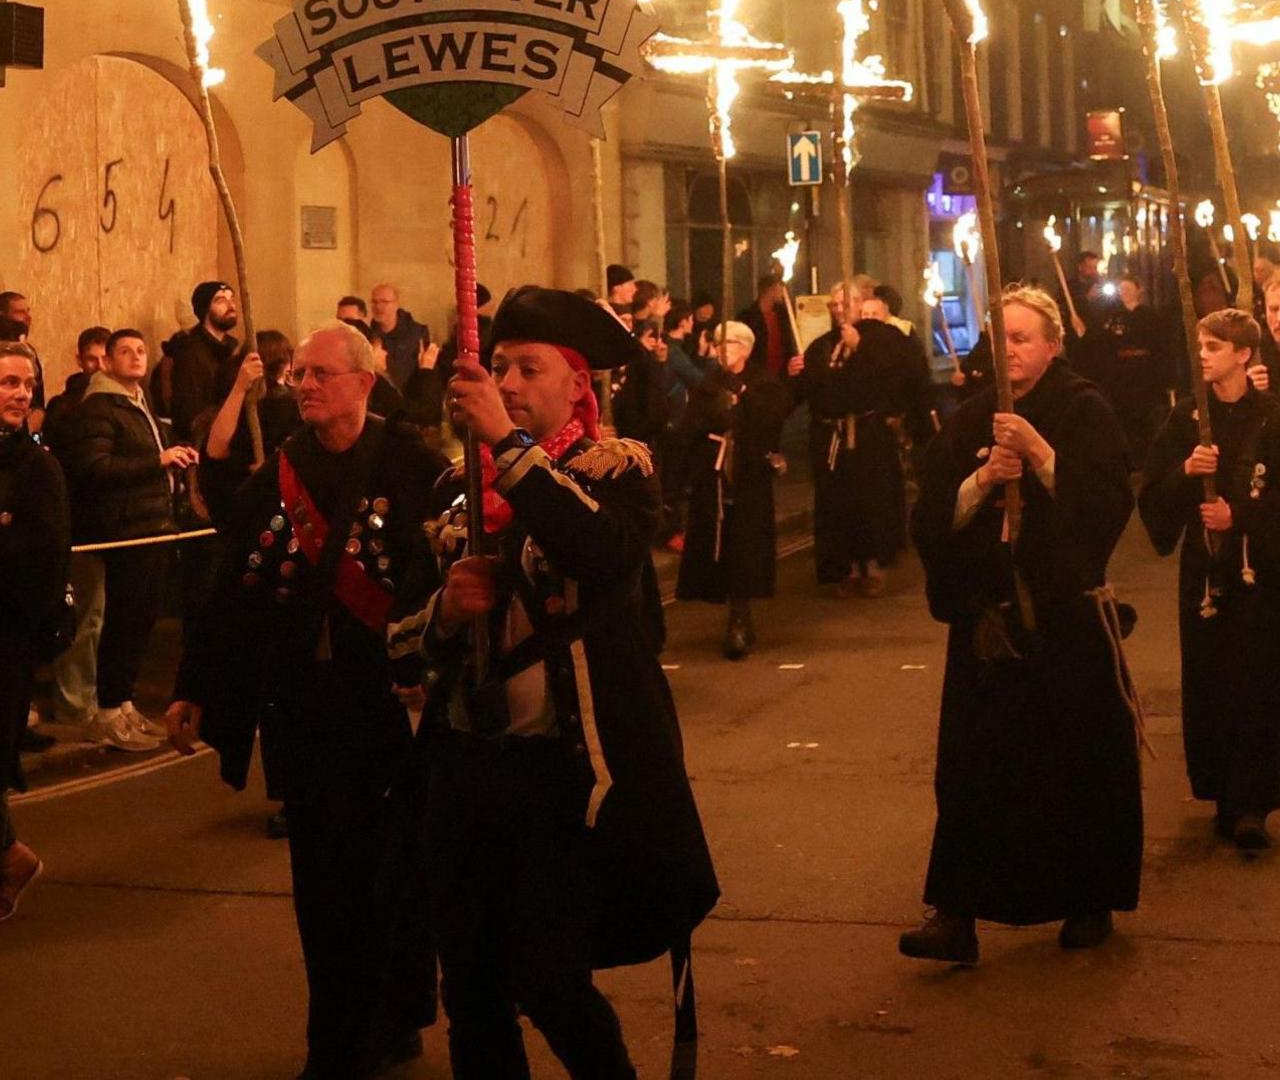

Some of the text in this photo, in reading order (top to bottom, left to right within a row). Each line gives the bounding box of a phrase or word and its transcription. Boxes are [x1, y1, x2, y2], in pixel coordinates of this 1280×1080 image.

[343, 31, 560, 93] LEWES
[31, 158, 175, 254] 6 5 4
